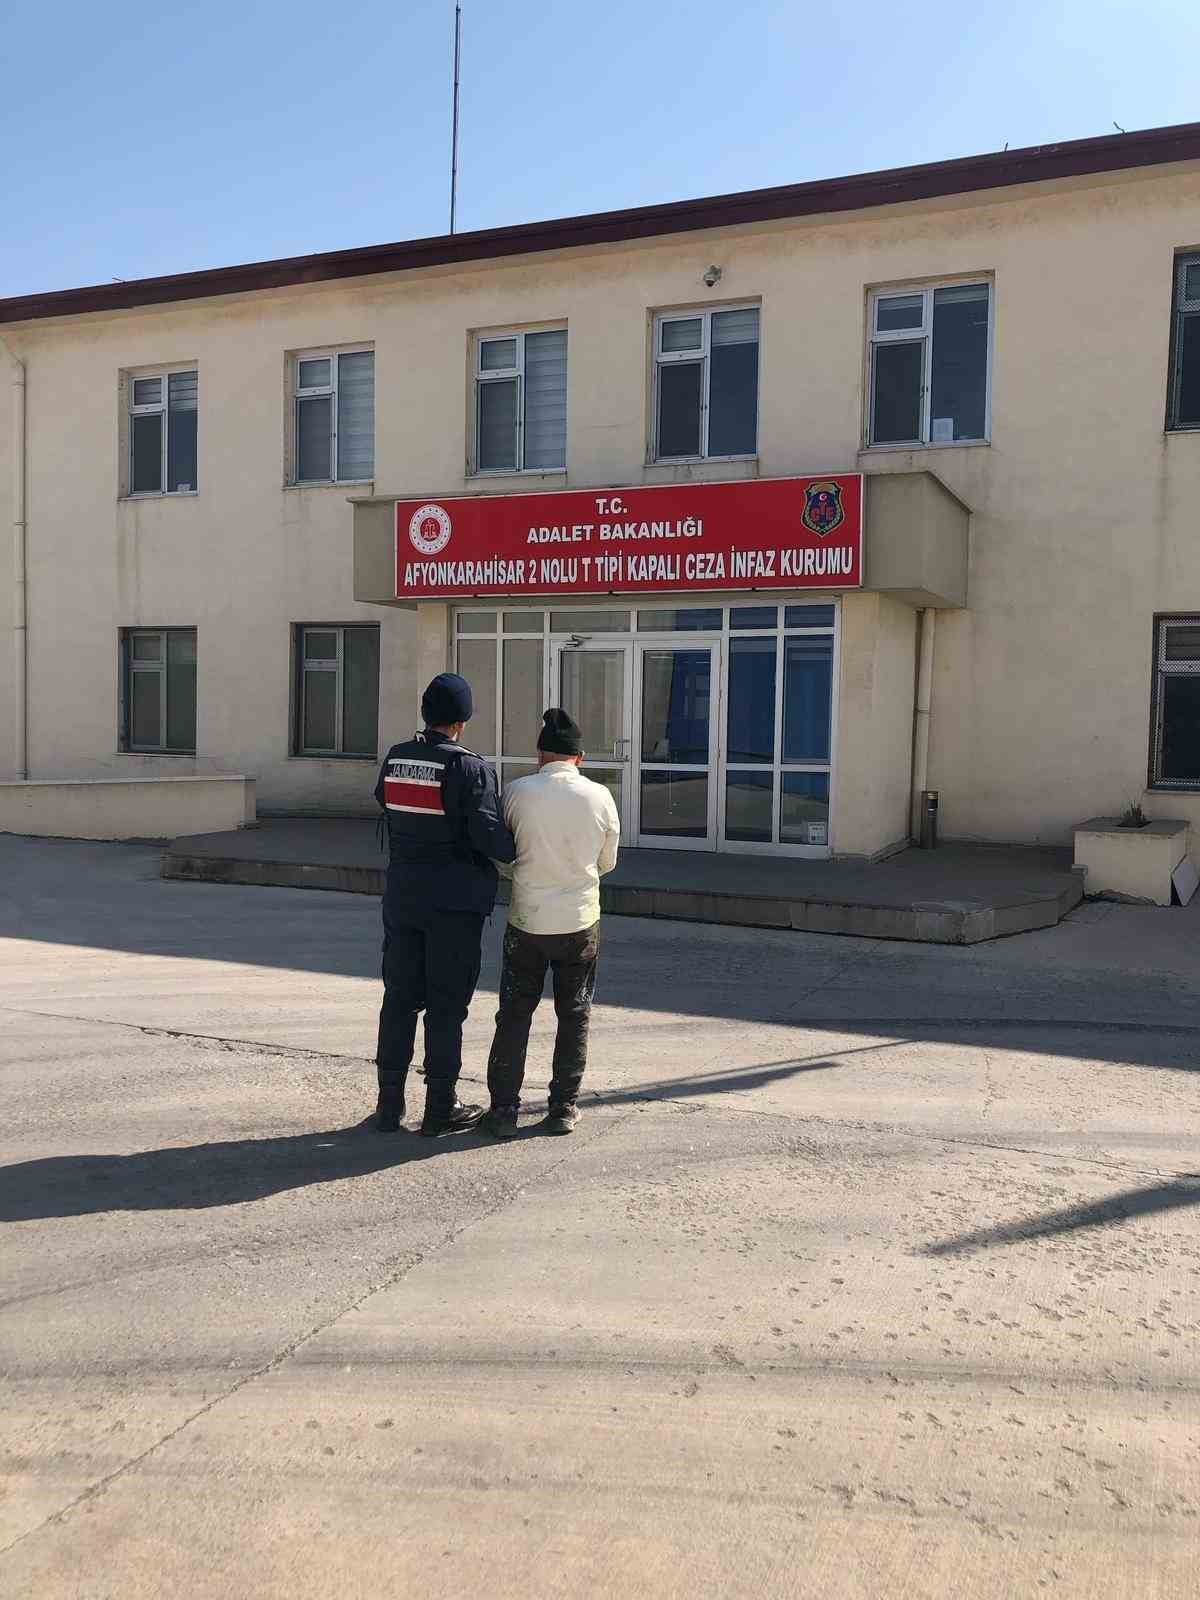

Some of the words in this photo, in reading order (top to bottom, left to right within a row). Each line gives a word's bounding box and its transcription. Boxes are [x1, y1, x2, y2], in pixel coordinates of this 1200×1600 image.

[595, 497, 628, 514] T.C.
[527, 524, 594, 543] ADALET
[599, 516, 703, 540] BAKANLIĞI
[404, 554, 525, 586] AFYONKARAHİSAR
[528, 559, 537, 584] 2
[541, 557, 578, 583] NOLU
[582, 557, 592, 582] T
[595, 550, 623, 582] TİPİ
[627, 554, 680, 581] KAPALI
[685, 552, 725, 580] CEZA
[730, 545, 776, 578] İNFAZ
[780, 547, 853, 576] KURUMU
[390, 764, 436, 781] JANDARMA
